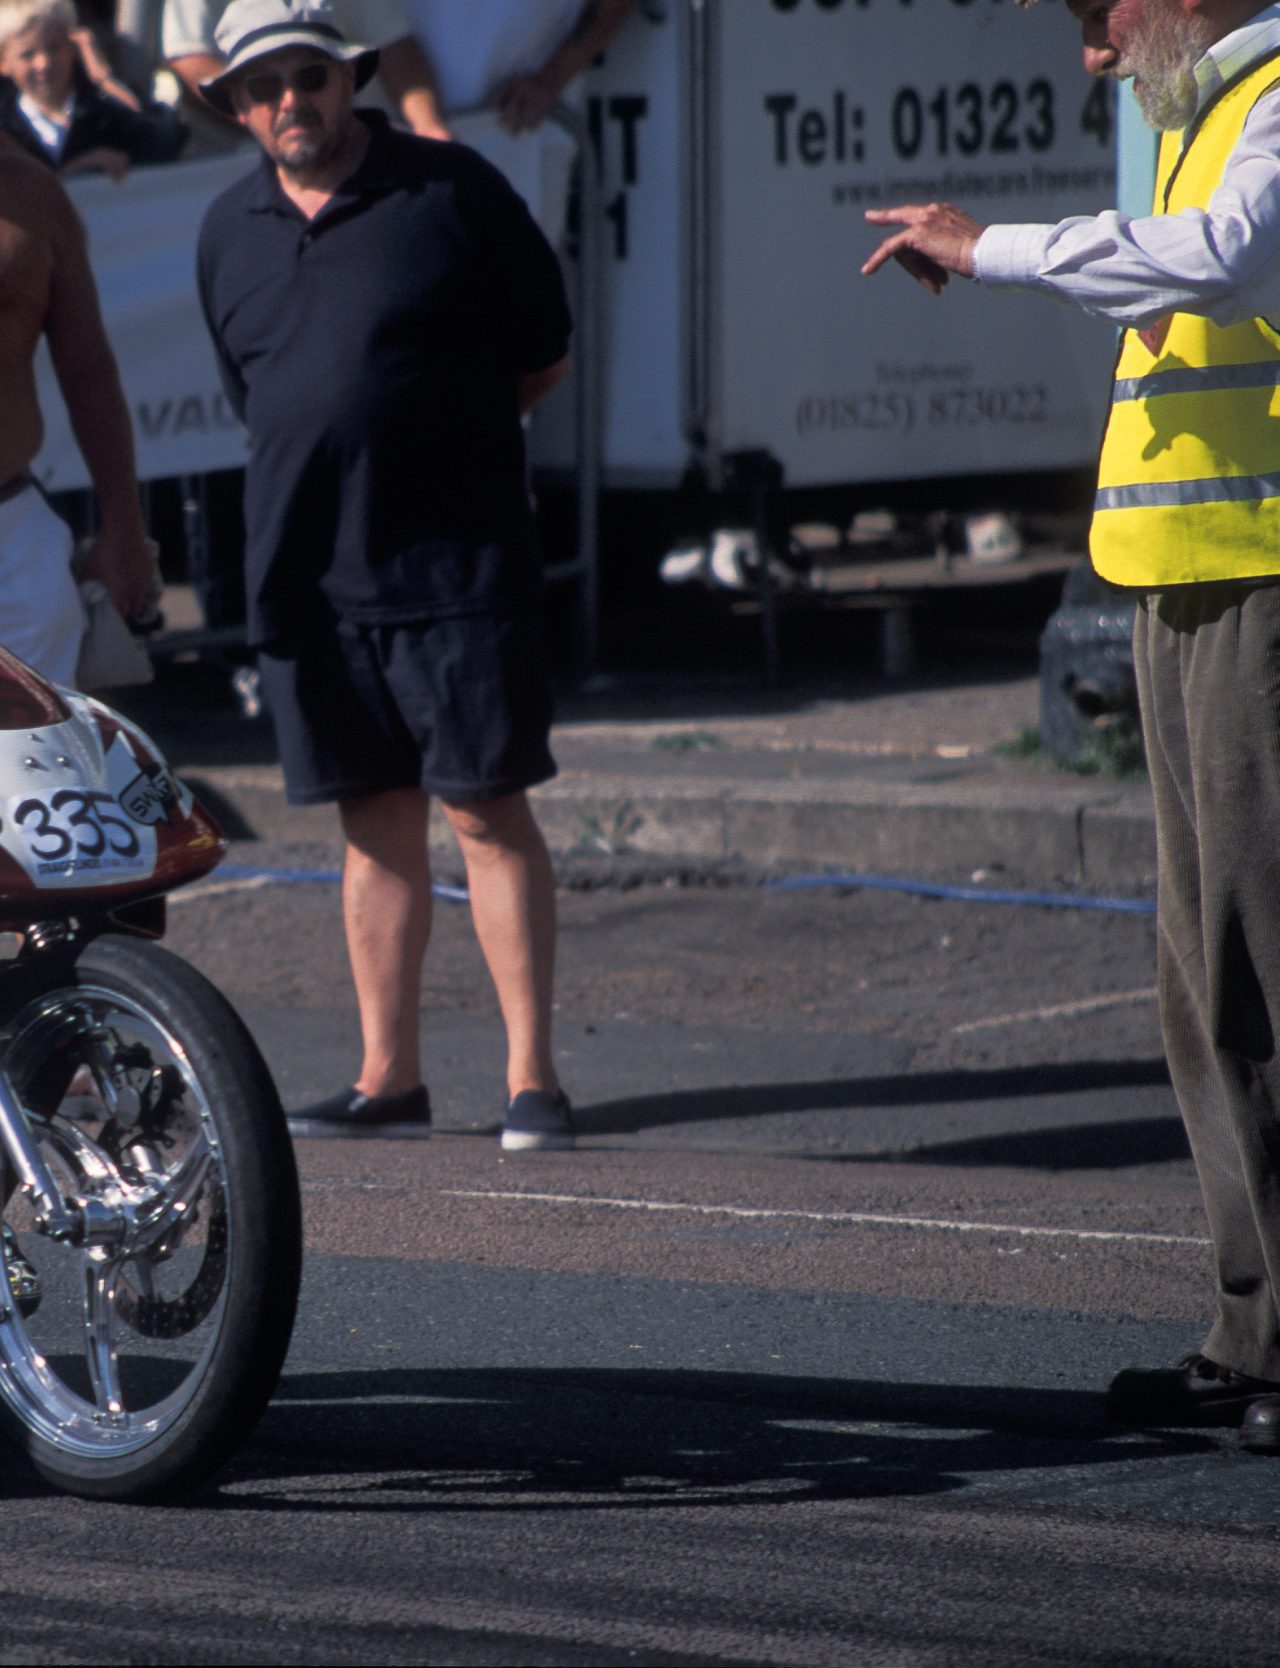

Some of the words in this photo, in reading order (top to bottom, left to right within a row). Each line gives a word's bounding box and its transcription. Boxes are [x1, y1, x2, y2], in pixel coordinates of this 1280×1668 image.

[765, 90, 864, 166] Tel:
[891, 79, 1056, 160] 01323
[15, 788, 141, 861] 335
